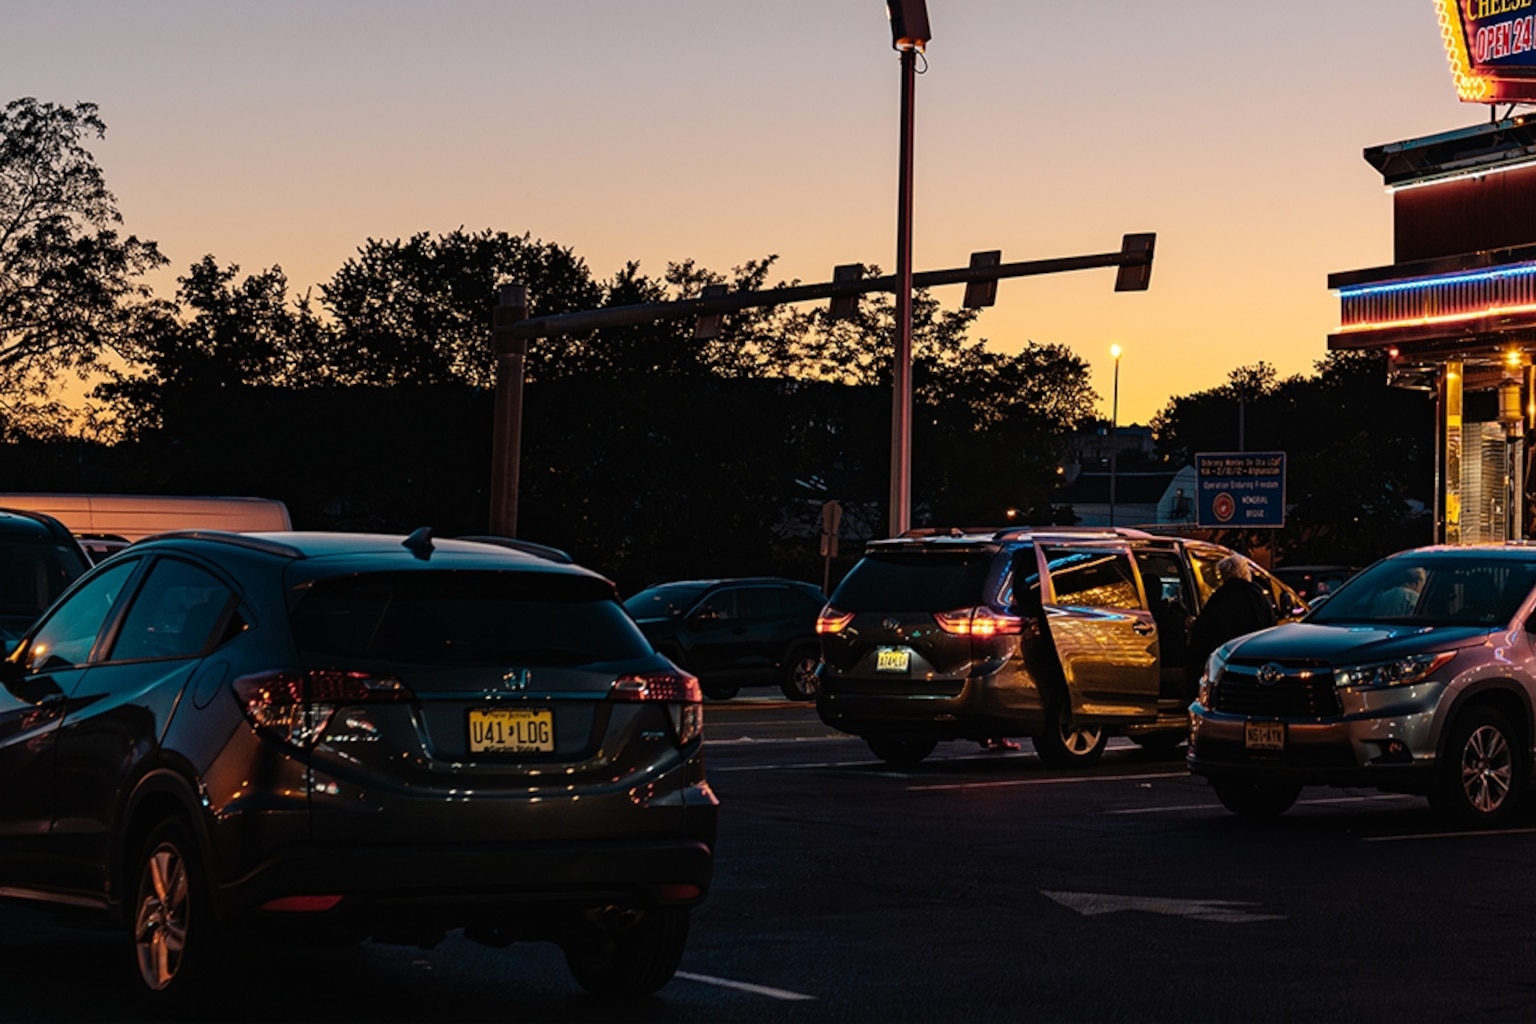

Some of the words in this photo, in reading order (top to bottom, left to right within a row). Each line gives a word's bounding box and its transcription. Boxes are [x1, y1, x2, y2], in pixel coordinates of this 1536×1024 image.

[1475, 20, 1511, 64] OPEN
[1511, 16, 1533, 56] 24
[1203, 480, 1229, 490] Operation
[1230, 480, 1254, 490] Enduring
[1255, 480, 1279, 489] Freedom
